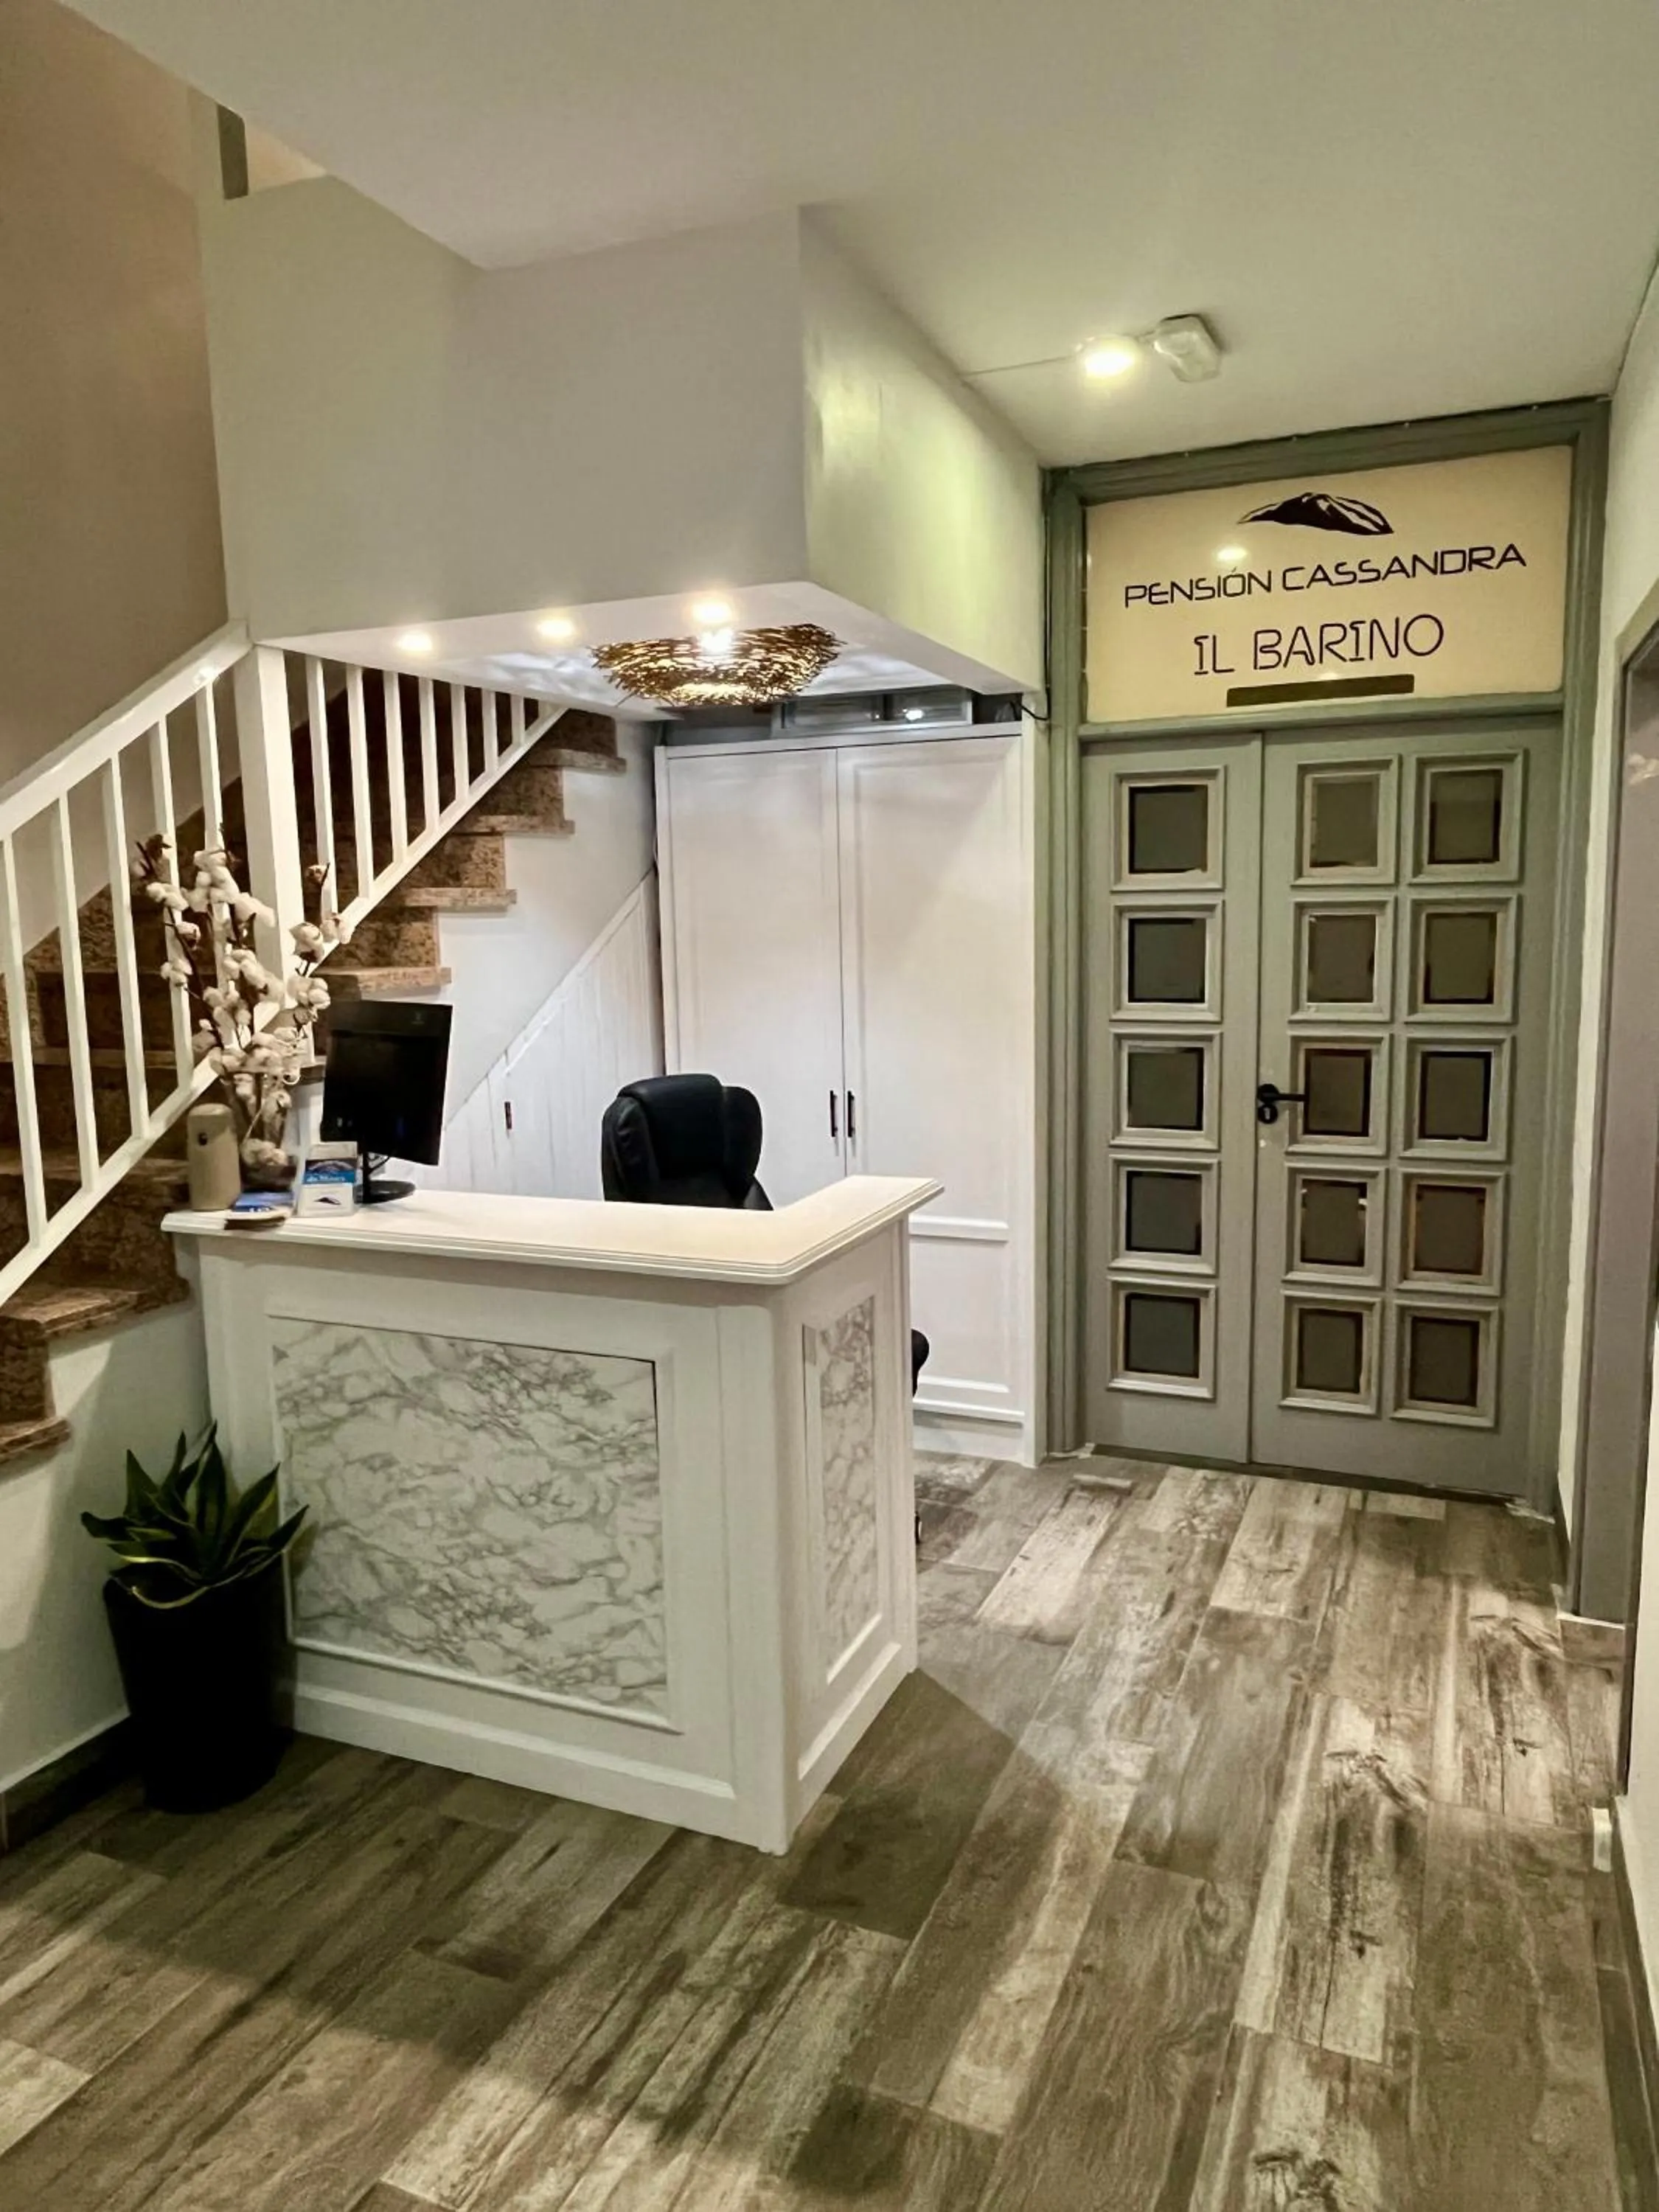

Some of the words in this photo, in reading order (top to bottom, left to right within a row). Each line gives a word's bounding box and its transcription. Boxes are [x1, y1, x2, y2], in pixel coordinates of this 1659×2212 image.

[1281, 543, 1527, 591] CASSANDRA
[1193, 634, 1235, 675] IL
[1253, 613, 1444, 670] BARINO
